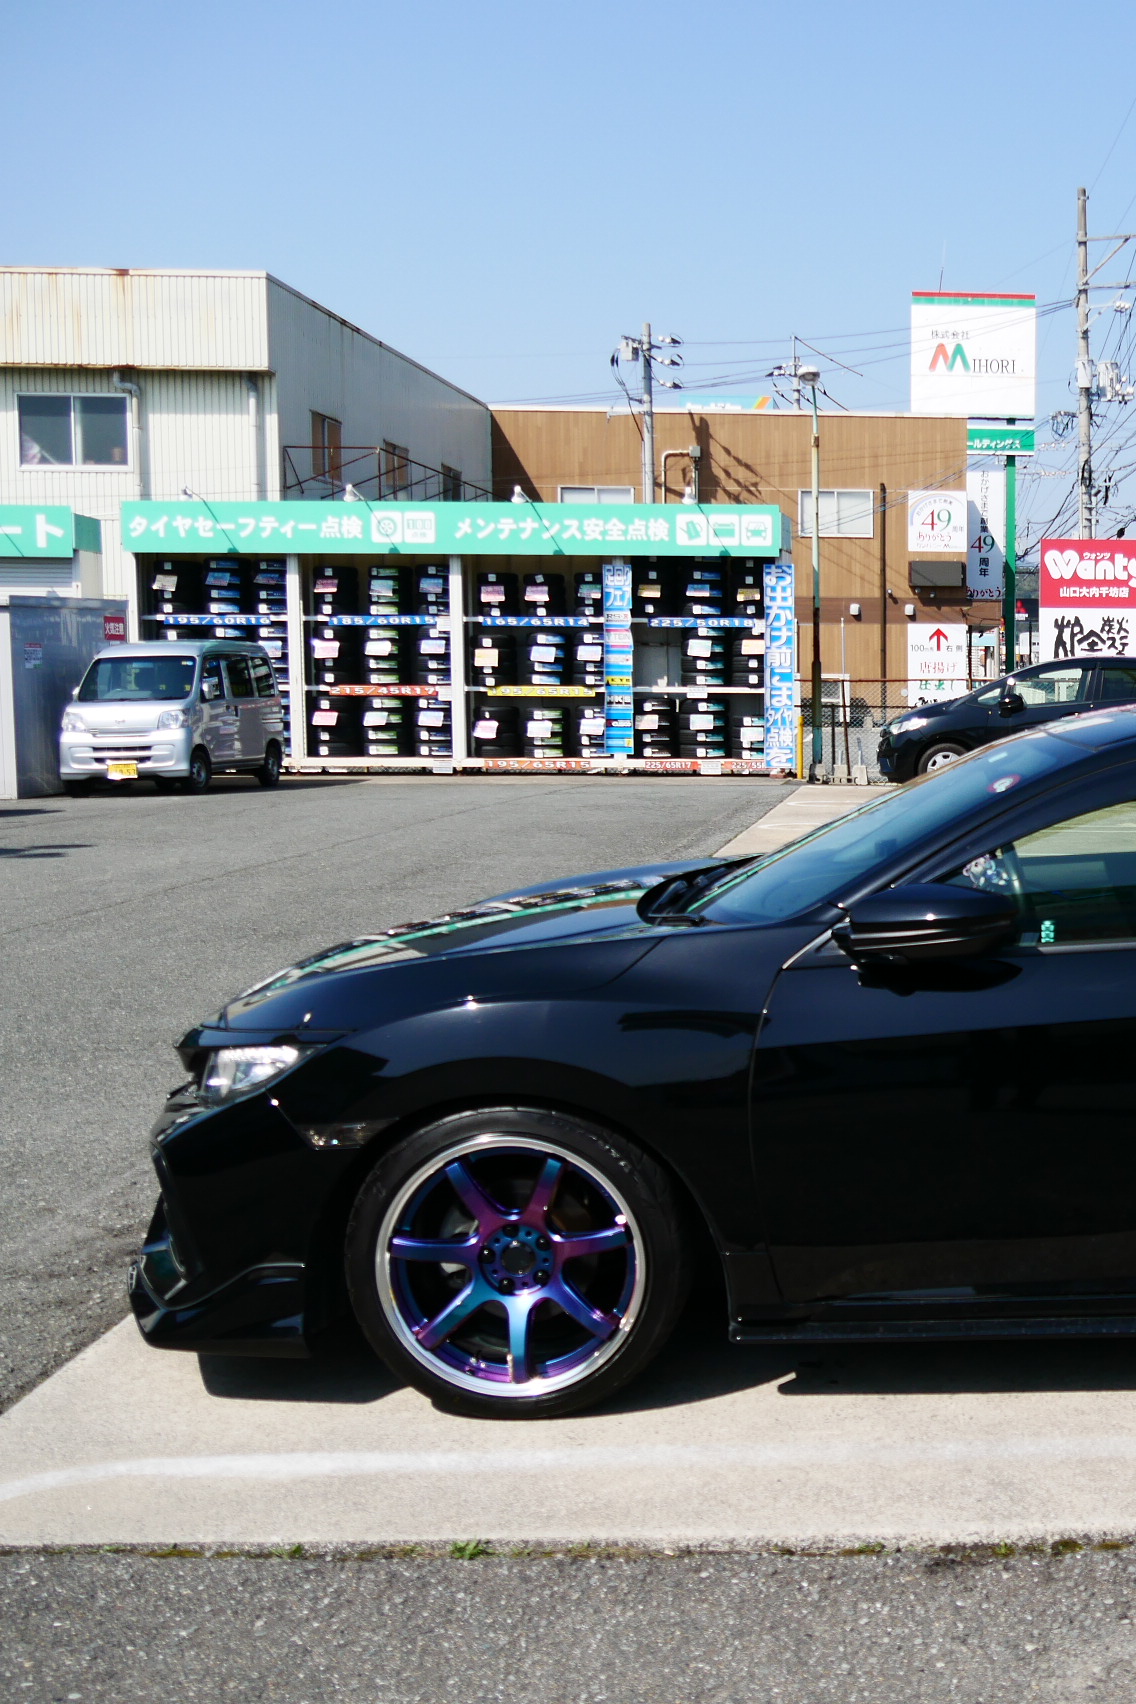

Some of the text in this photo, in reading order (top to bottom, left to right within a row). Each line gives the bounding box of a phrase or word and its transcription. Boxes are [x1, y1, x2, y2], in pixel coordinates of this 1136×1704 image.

[931, 329, 970, 340] 株式会社
[929, 343, 1017, 374] MIHORI
[921, 509, 952, 532] 49
[129, 515, 363, 539] タイヤセーフティー点検
[455, 517, 670, 541] メンテナンス安全点検
[1083, 552, 1111, 560] ウォンツ
[604, 587, 631, 607] フェア
[1060, 587, 1130, 598] 山口大内千坊店
[167, 616, 271, 625] 195/60R16
[331, 616, 436, 625] 185/60R15
[484, 617, 589, 626] 165/65R14
[650, 618, 754, 627] 225/50R18
[331, 686, 437, 695] 215/45R17
[491, 687, 594, 696] 195/65R15
[486, 760, 591, 769] 195/65R15
[645, 761, 692, 769] 225/65R17
